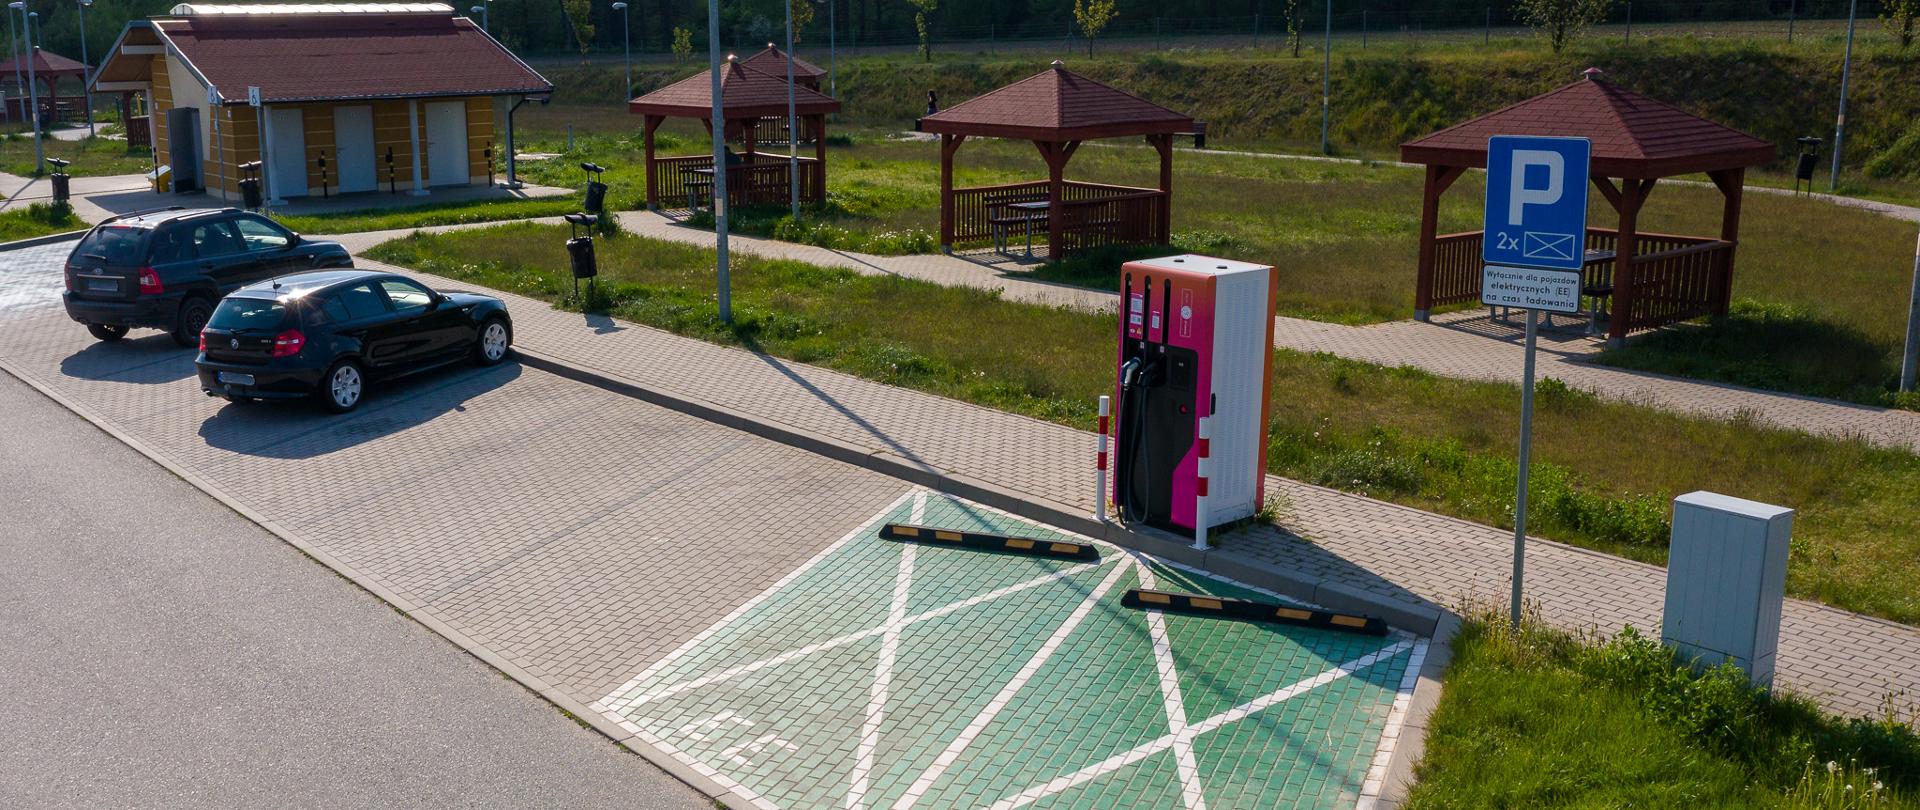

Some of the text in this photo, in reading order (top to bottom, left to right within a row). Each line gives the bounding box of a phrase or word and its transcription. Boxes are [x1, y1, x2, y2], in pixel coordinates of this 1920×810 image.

[1508, 149, 1565, 226] P
[1496, 232, 1519, 251] 2x
[1526, 273, 1538, 281] dla
[1491, 282, 1570, 297] elektrycznych (EE)
[1502, 295, 1521, 303] czas
[1526, 296, 1574, 308] ładowania
